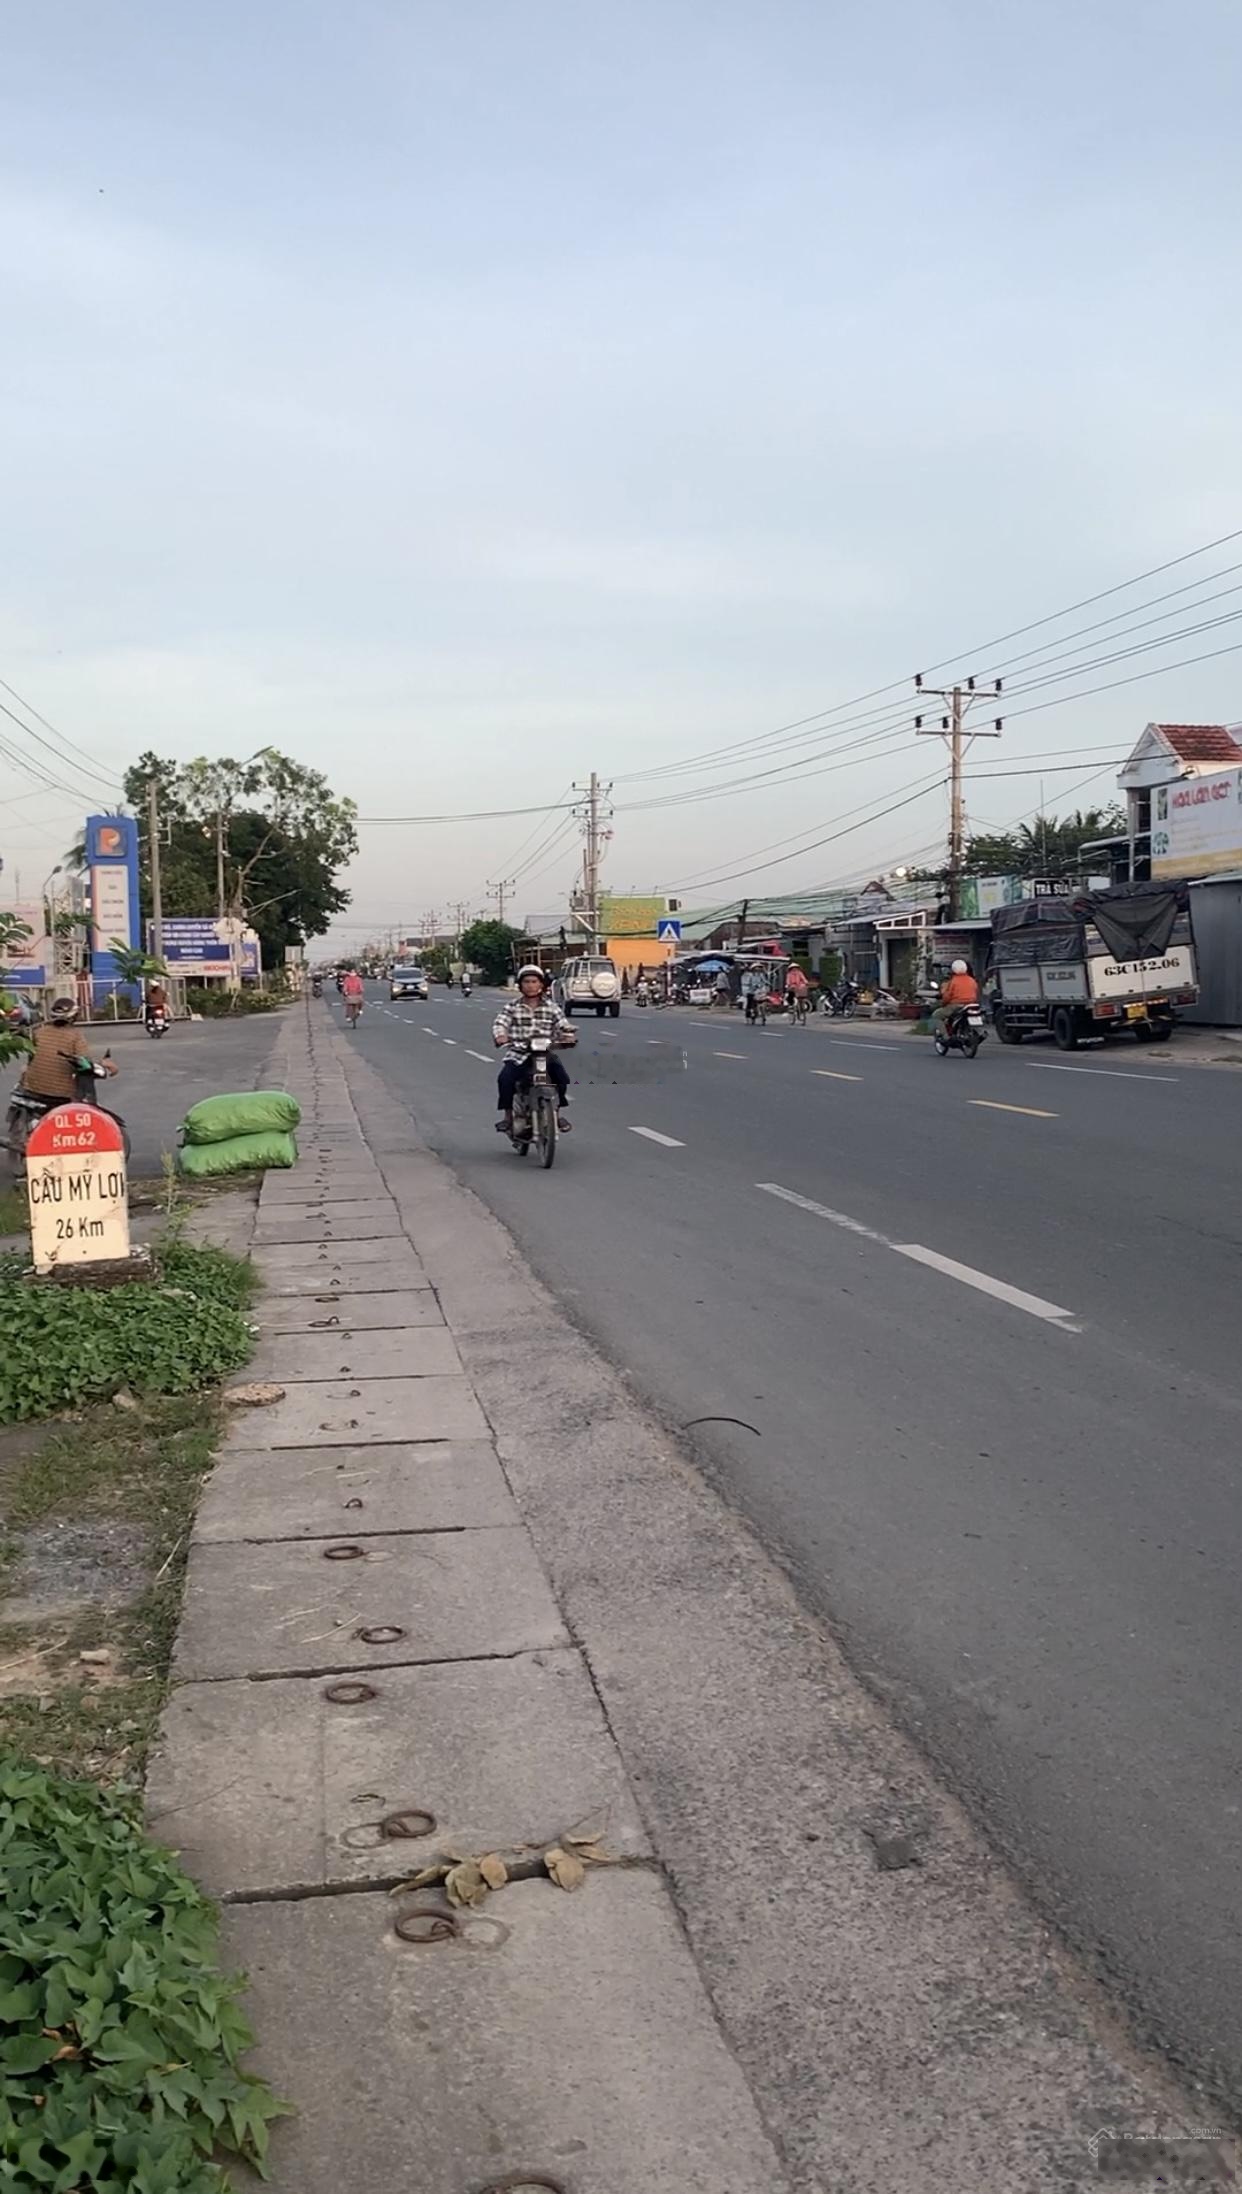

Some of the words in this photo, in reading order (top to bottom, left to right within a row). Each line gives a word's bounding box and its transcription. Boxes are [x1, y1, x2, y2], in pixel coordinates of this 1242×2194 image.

[55, 1114, 73, 1128] QL
[75, 1112, 91, 1128] 50
[30, 1167, 62, 1204] CẦU
[68, 1169, 92, 1202] MỸ
[98, 1172, 125, 1204] LỢI
[56, 1218, 74, 1239] 26
[79, 1216, 105, 1238] Km
